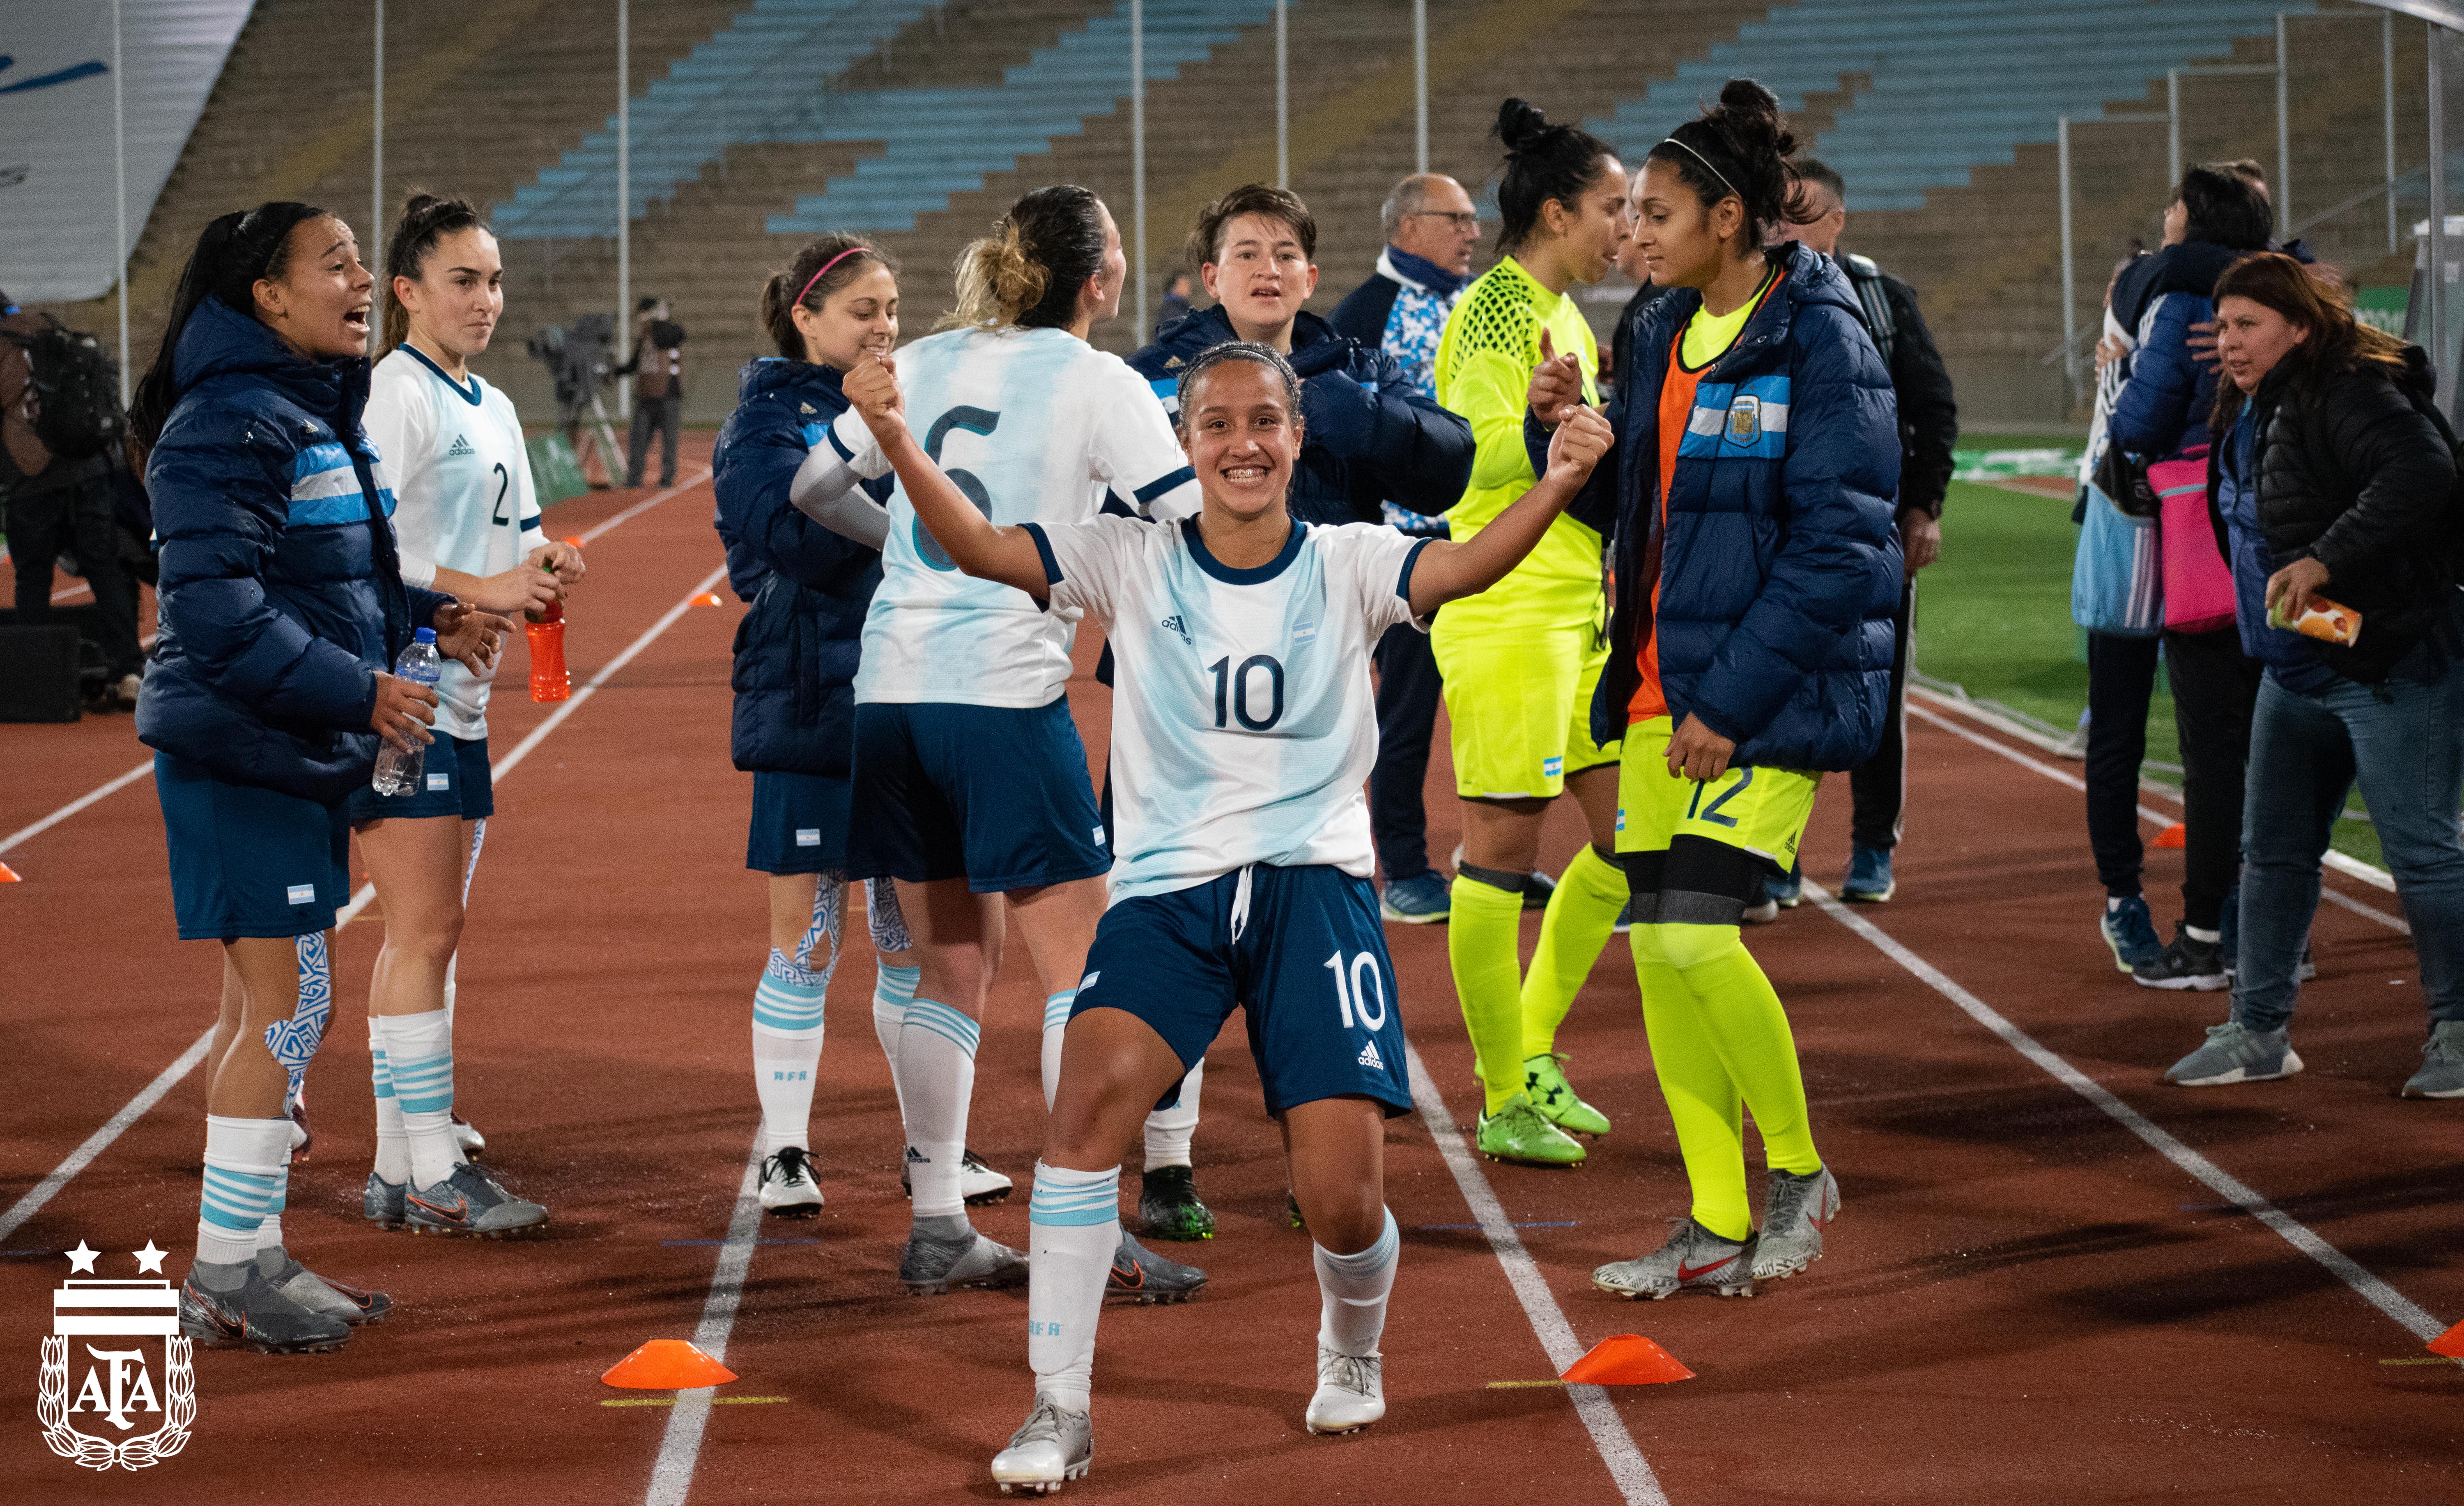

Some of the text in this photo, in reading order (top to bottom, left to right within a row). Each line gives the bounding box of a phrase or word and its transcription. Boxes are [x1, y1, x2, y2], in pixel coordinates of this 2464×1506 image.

[449, 447, 475, 456] adidas
[492, 462, 509, 526] 2
[912, 405, 1001, 572] 6
[1161, 620, 1191, 645] adias
[1207, 654, 1284, 731] 10
[1687, 767, 1753, 828] 12
[1324, 950, 1385, 1031] 10
[1358, 1054, 1384, 1070] adidas
